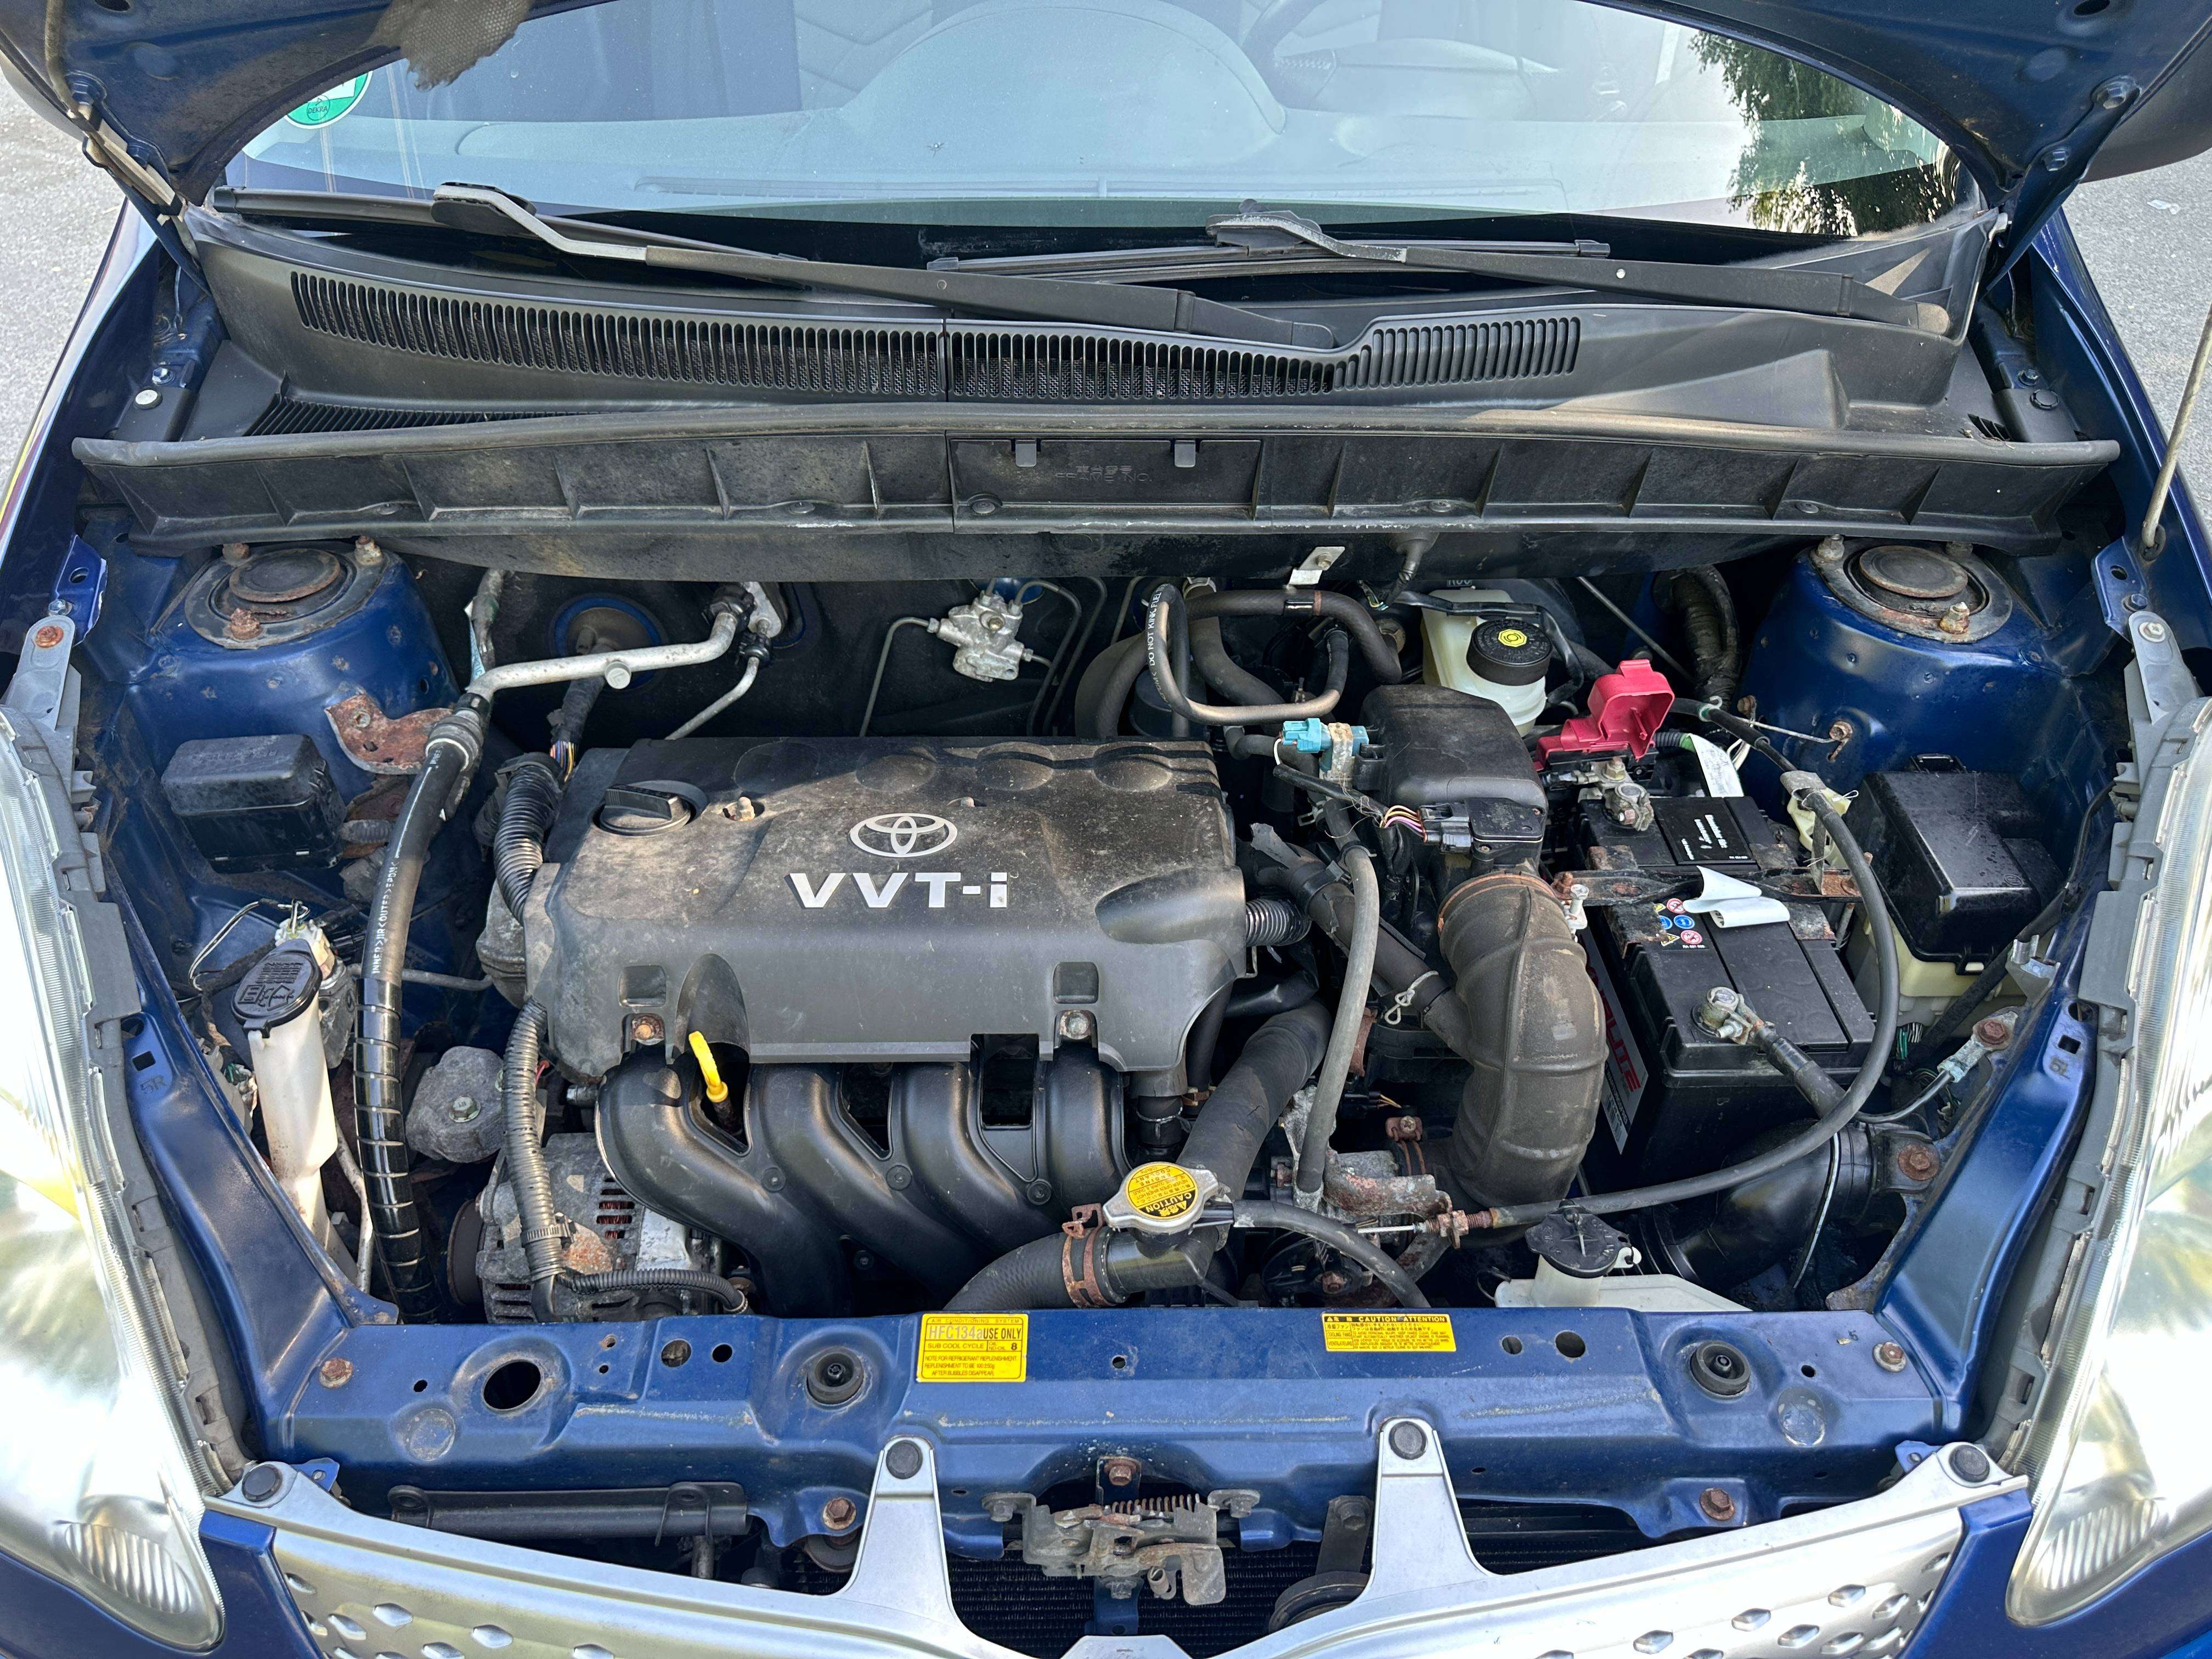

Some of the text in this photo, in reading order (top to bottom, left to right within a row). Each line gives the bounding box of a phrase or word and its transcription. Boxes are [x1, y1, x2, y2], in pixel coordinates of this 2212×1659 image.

[308, 106, 328, 114] DEKRA
[1054, 472, 1153, 483] FRAME NO.
[1150, 591, 1162, 607] FUEL
[1149, 653, 1155, 666] DO
[789, 872, 1008, 909] VVT-i
[1145, 1192, 1192, 1212] CAUTION
[929, 1325, 1022, 1340] HFC134a USE ONLY
